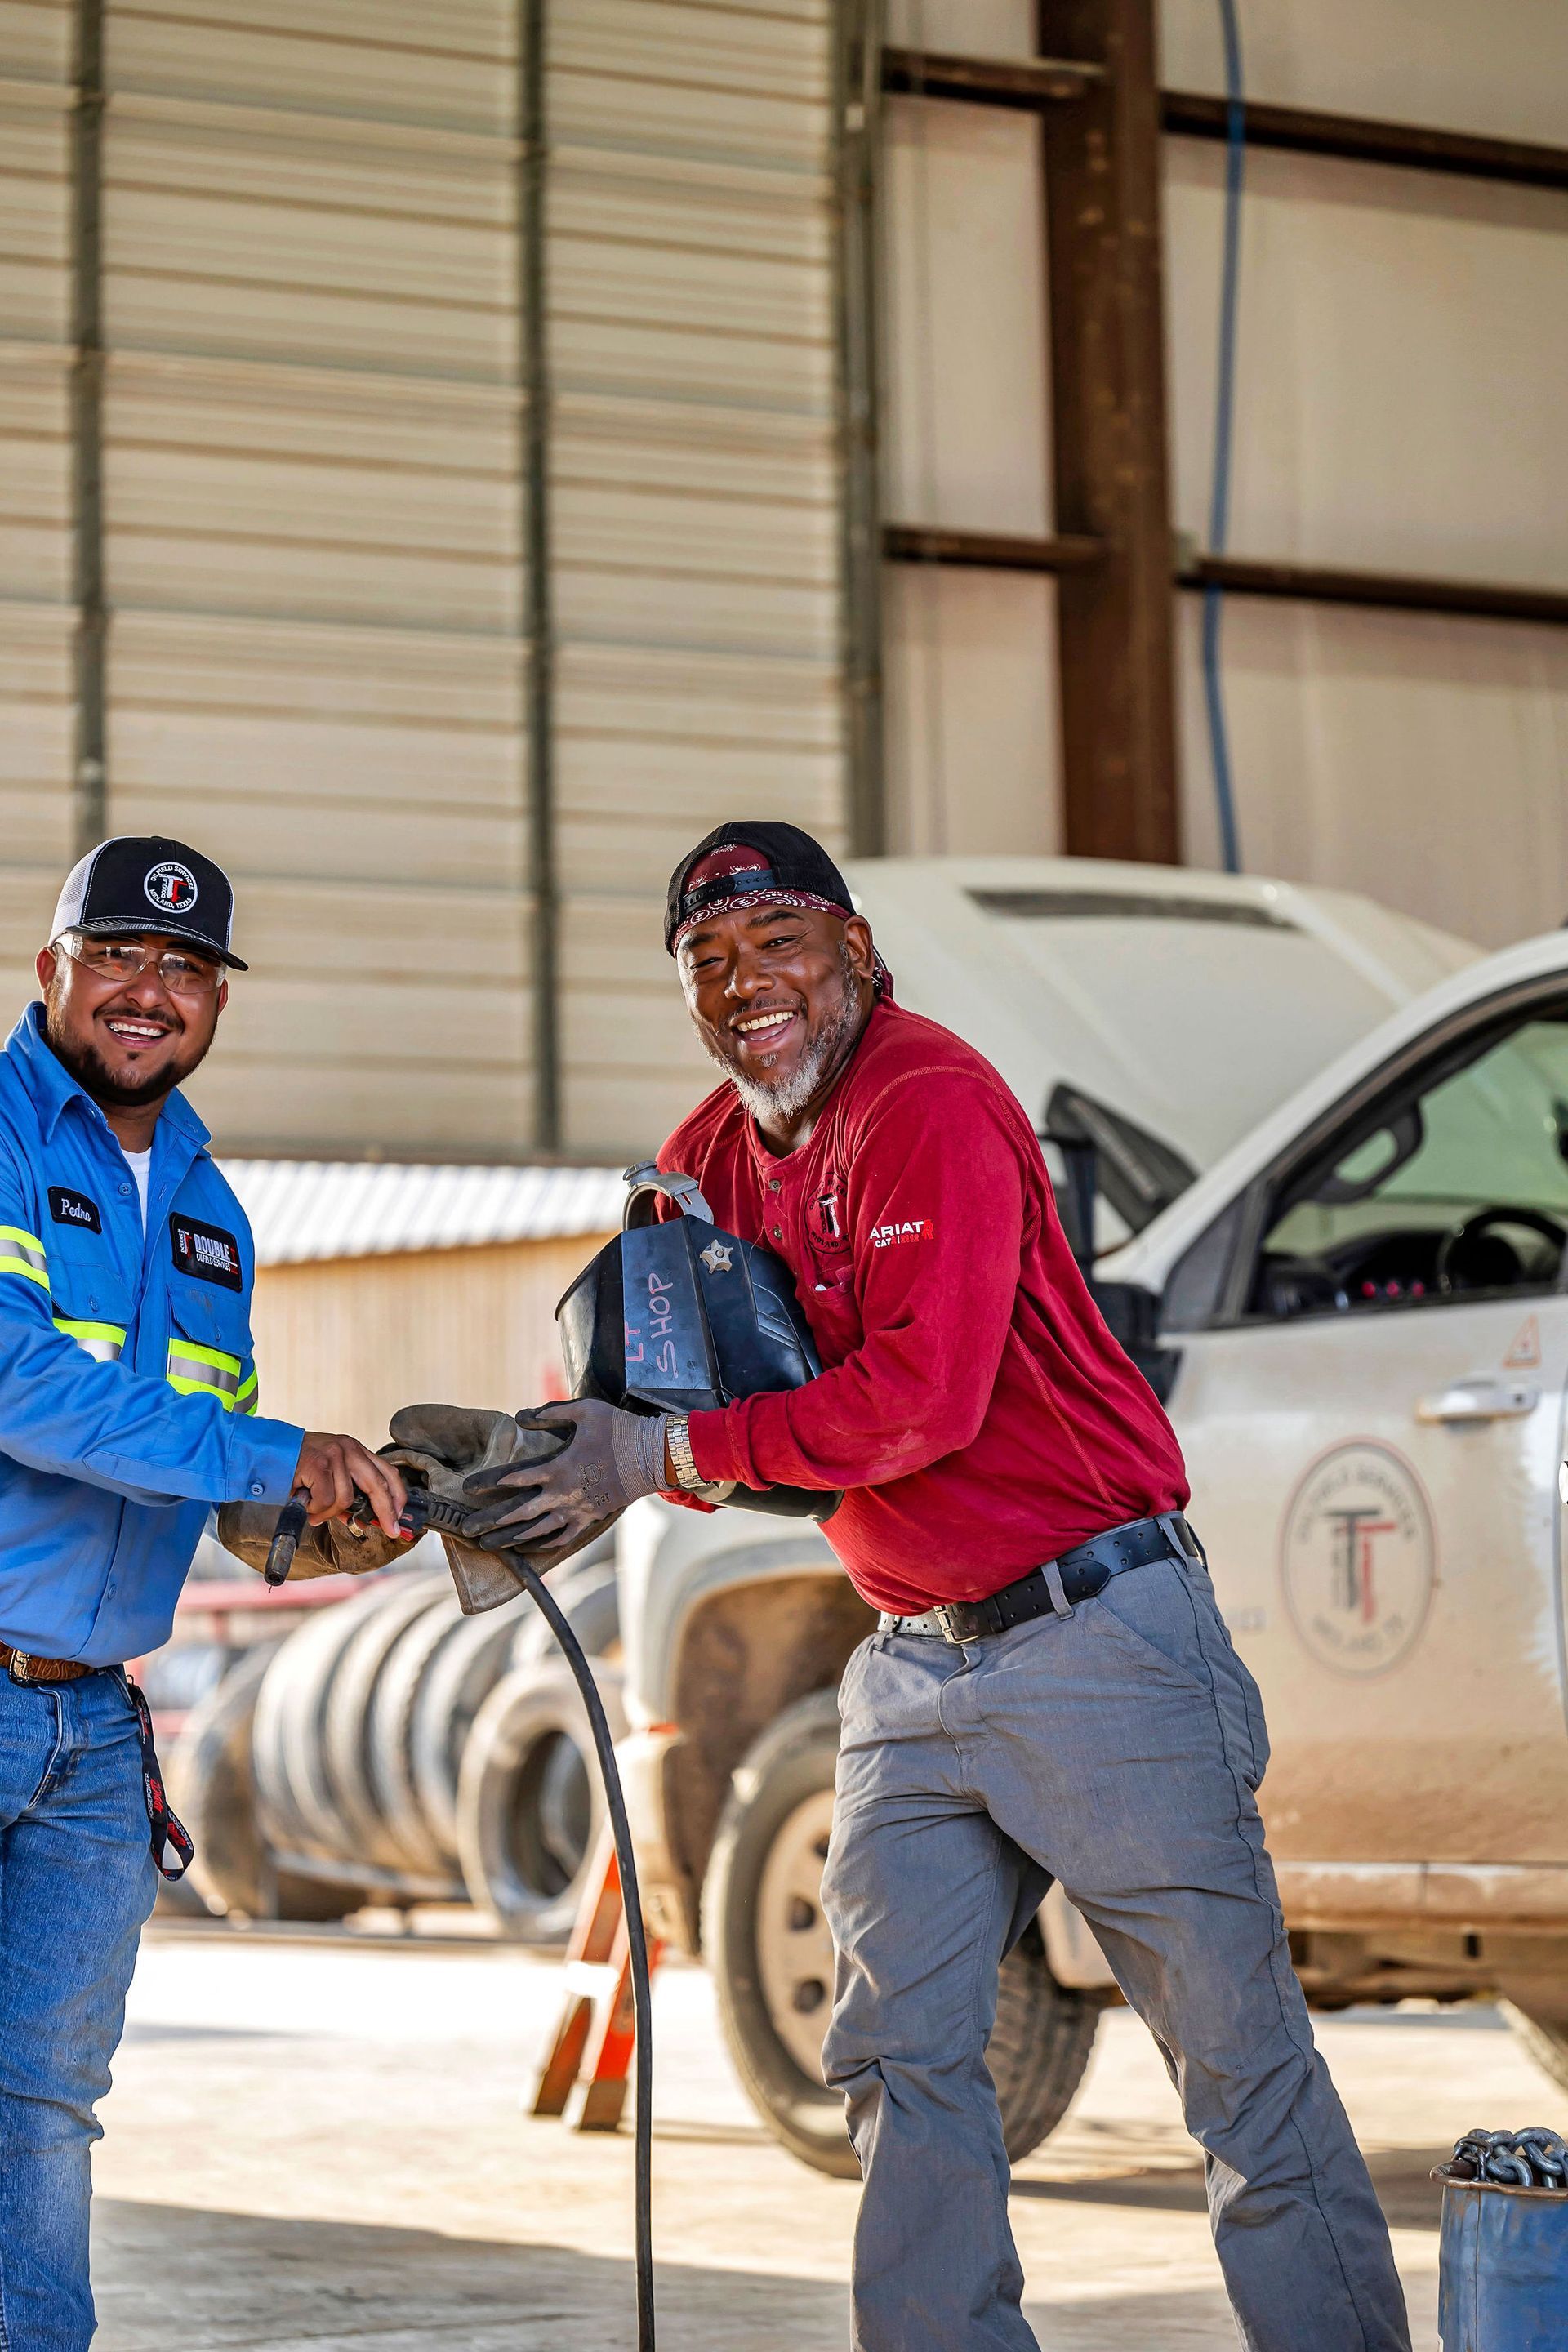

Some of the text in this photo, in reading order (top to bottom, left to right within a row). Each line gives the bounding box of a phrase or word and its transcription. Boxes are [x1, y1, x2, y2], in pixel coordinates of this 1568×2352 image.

[150, 866, 194, 890] OILFIELD SERVICES
[176, 897, 193, 909] TEXAS
[61, 1197, 92, 1222] Pedro
[869, 1221, 924, 1240] ARIAT
[194, 1233, 230, 1262] DOUBLE
[196, 1253, 213, 1265] OILFIELD
[213, 1258, 231, 1272] SERVICES
[648, 1272, 679, 1379] SHOP
